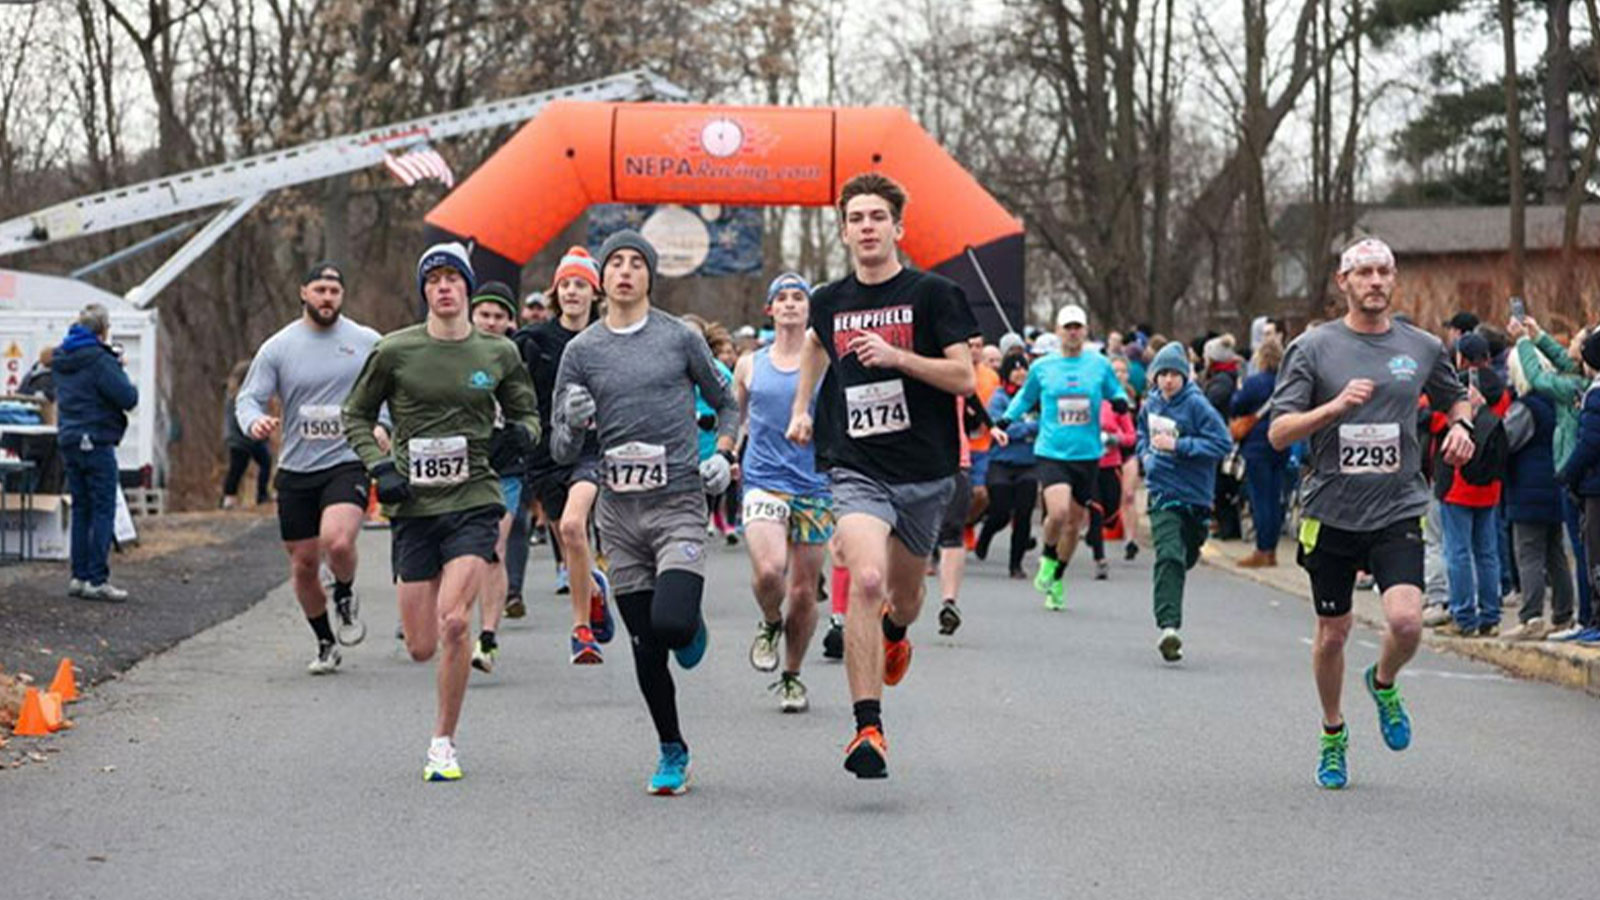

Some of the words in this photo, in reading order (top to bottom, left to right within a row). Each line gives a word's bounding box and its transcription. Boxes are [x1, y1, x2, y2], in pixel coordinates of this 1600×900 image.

[302, 420, 340, 435] 1503
[851, 403, 906, 431] 2174
[1342, 446, 1397, 467] 2293
[413, 457, 464, 478] 1857
[609, 464, 662, 485] 1774
[745, 502, 787, 518] 1759
